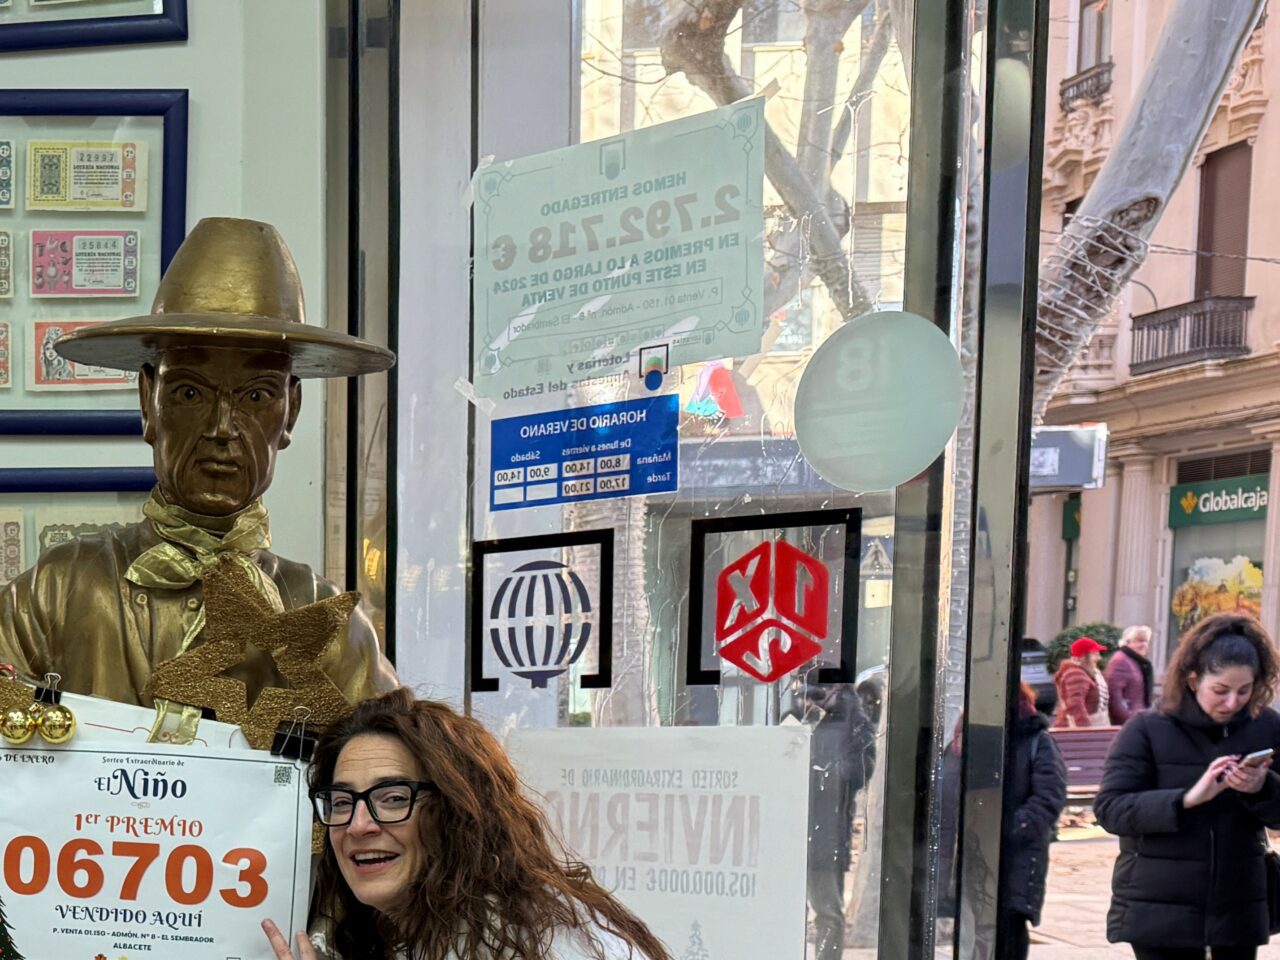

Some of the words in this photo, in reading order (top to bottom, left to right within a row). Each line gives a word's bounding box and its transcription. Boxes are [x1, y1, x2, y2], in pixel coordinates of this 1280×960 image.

[1199, 486, 1268, 514] Globalcaja
[4, 754, 19, 762] DE
[20, 754, 55, 764] ENERO
[102, 756, 124, 764] Sorteo
[126, 756, 176, 766] Extraordinario
[110, 768, 188, 800] Niño
[105, 814, 204, 838] PREMIO
[2, 835, 269, 909] 06703
[54, 904, 148, 924] VENDIDO
[148, 910, 202, 930] AQUÍ
[60, 928, 84, 936] VENTA
[111, 930, 140, 939] ADMÓN.
[170, 934, 214, 944] SEMBRADOR
[112, 942, 152, 951] ALBACETE
